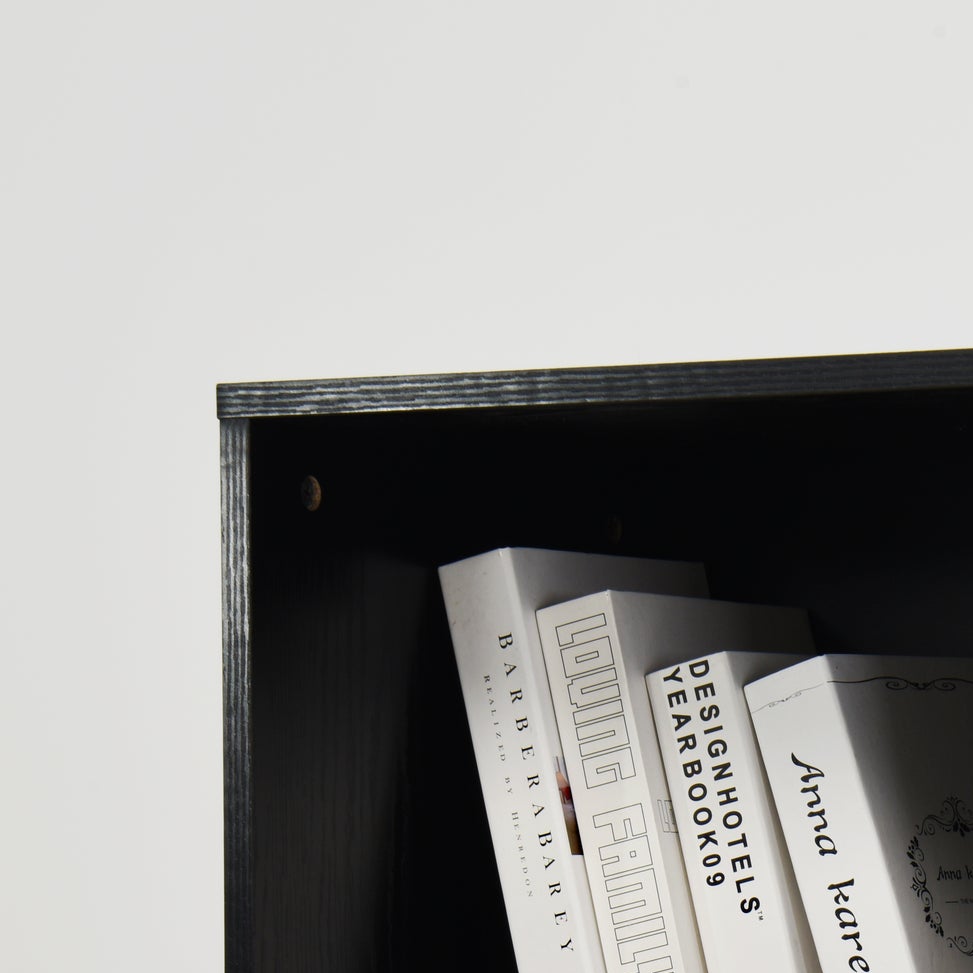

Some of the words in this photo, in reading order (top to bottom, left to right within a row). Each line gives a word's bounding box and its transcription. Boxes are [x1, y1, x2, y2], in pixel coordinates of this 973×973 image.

[483, 675, 506, 762] REALIZED
[504, 776, 513, 794] BY
[511, 811, 534, 897] HENREDON
[791, 752, 838, 857] Anna
[936, 865, 961, 881] Anna
